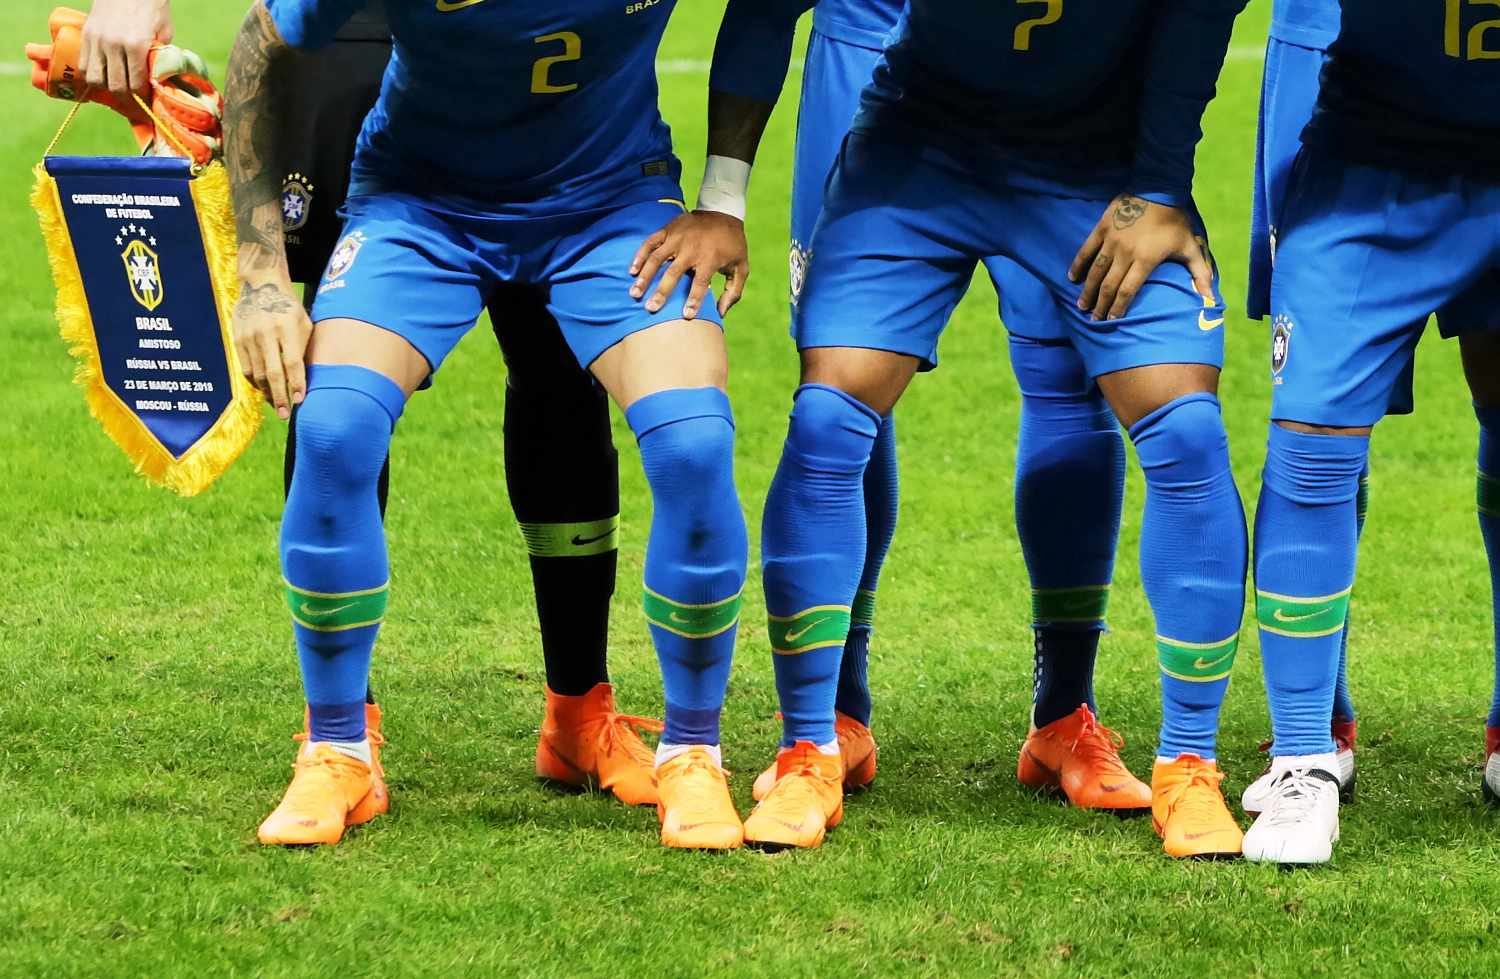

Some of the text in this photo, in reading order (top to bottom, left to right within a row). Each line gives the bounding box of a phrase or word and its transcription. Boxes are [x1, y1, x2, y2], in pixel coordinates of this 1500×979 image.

[530, 30, 582, 94] 2
[72, 193, 181, 207] CONFEDERAÇÃO BRASILEIRA
[105, 208, 154, 219] DE FUTEBOL
[138, 268, 150, 276] CBF
[135, 317, 173, 331] BRASIL
[139, 339, 181, 350] AMISTOSO
[126, 357, 202, 371] RÚSSIA VS BRASIL
[124, 380, 214, 393] 23 DE MARÇO DE 2018
[136, 400, 172, 411] MOSCOU
[177, 399, 210, 412] RÚSSIA
